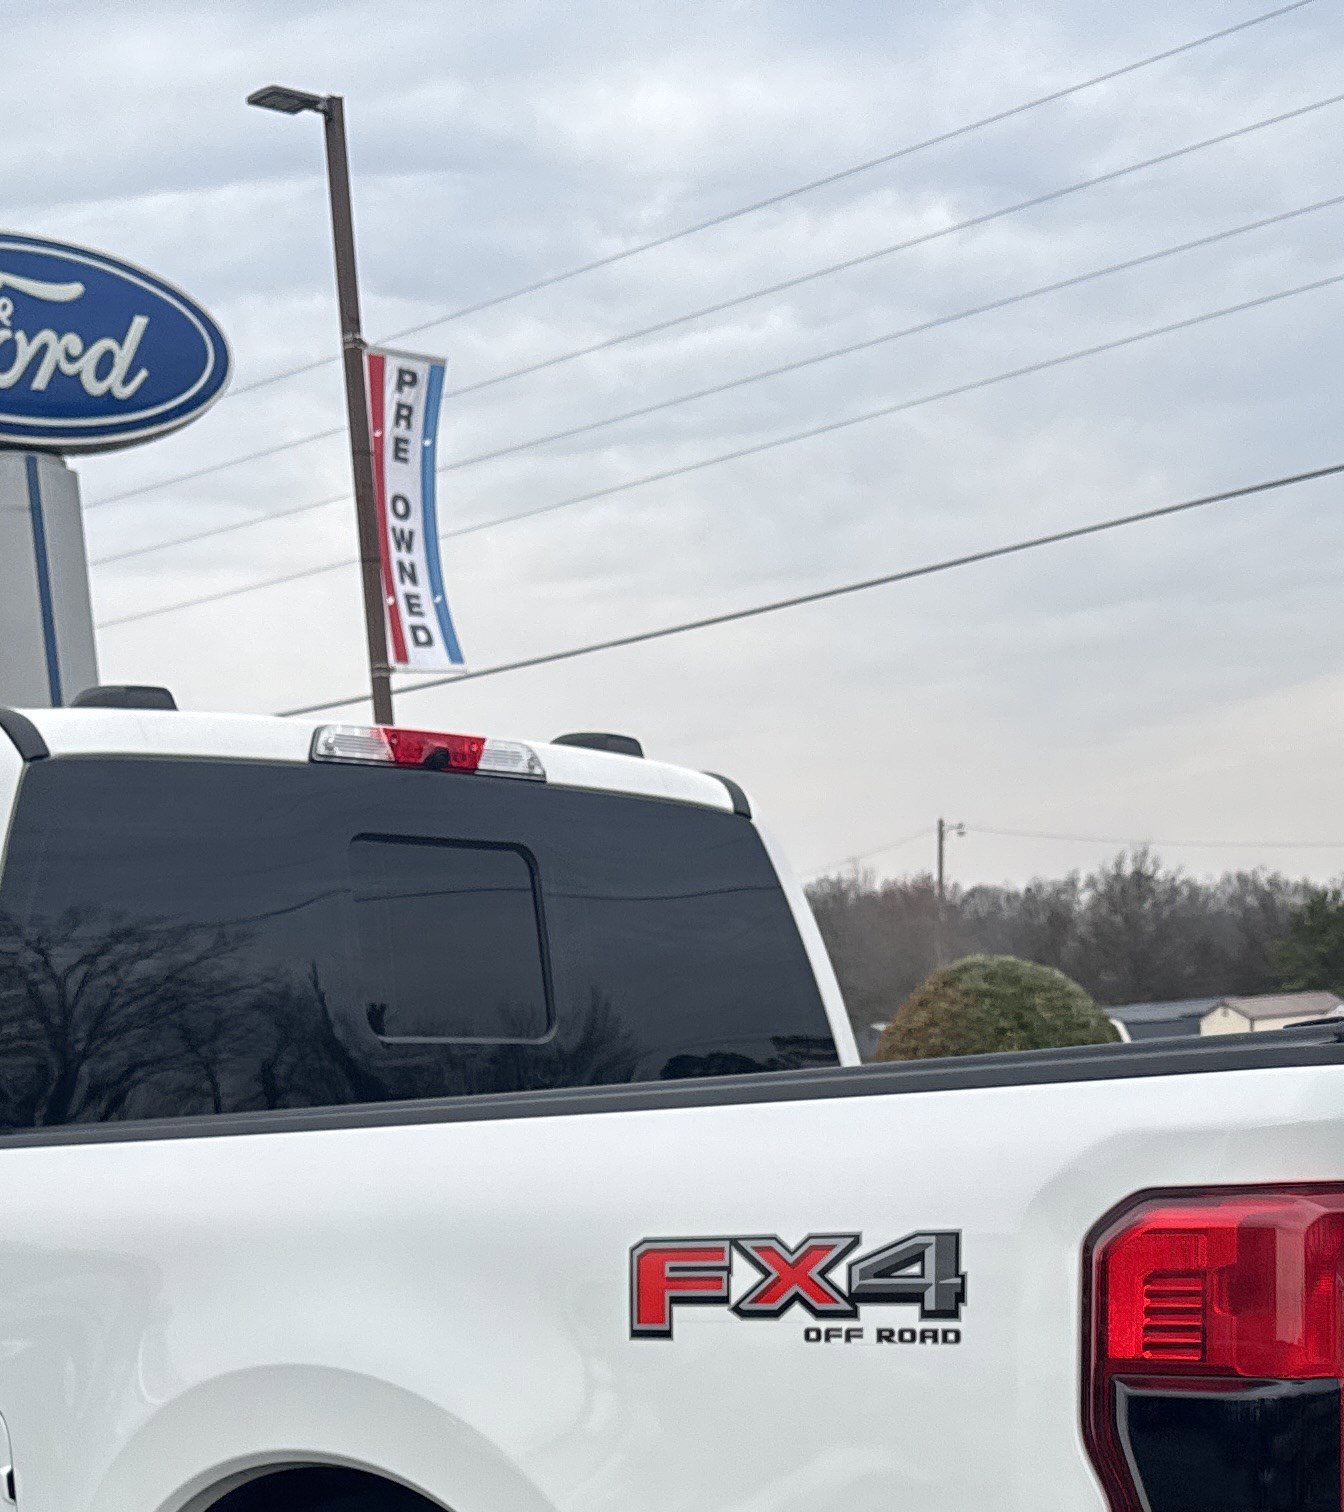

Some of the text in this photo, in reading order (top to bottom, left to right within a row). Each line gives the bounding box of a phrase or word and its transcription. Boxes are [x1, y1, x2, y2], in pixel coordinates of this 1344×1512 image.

[391, 367, 434, 648] PRE OWNED
[629, 1229, 968, 1341] FX4
[804, 1326, 962, 1345] OFF ROAD
